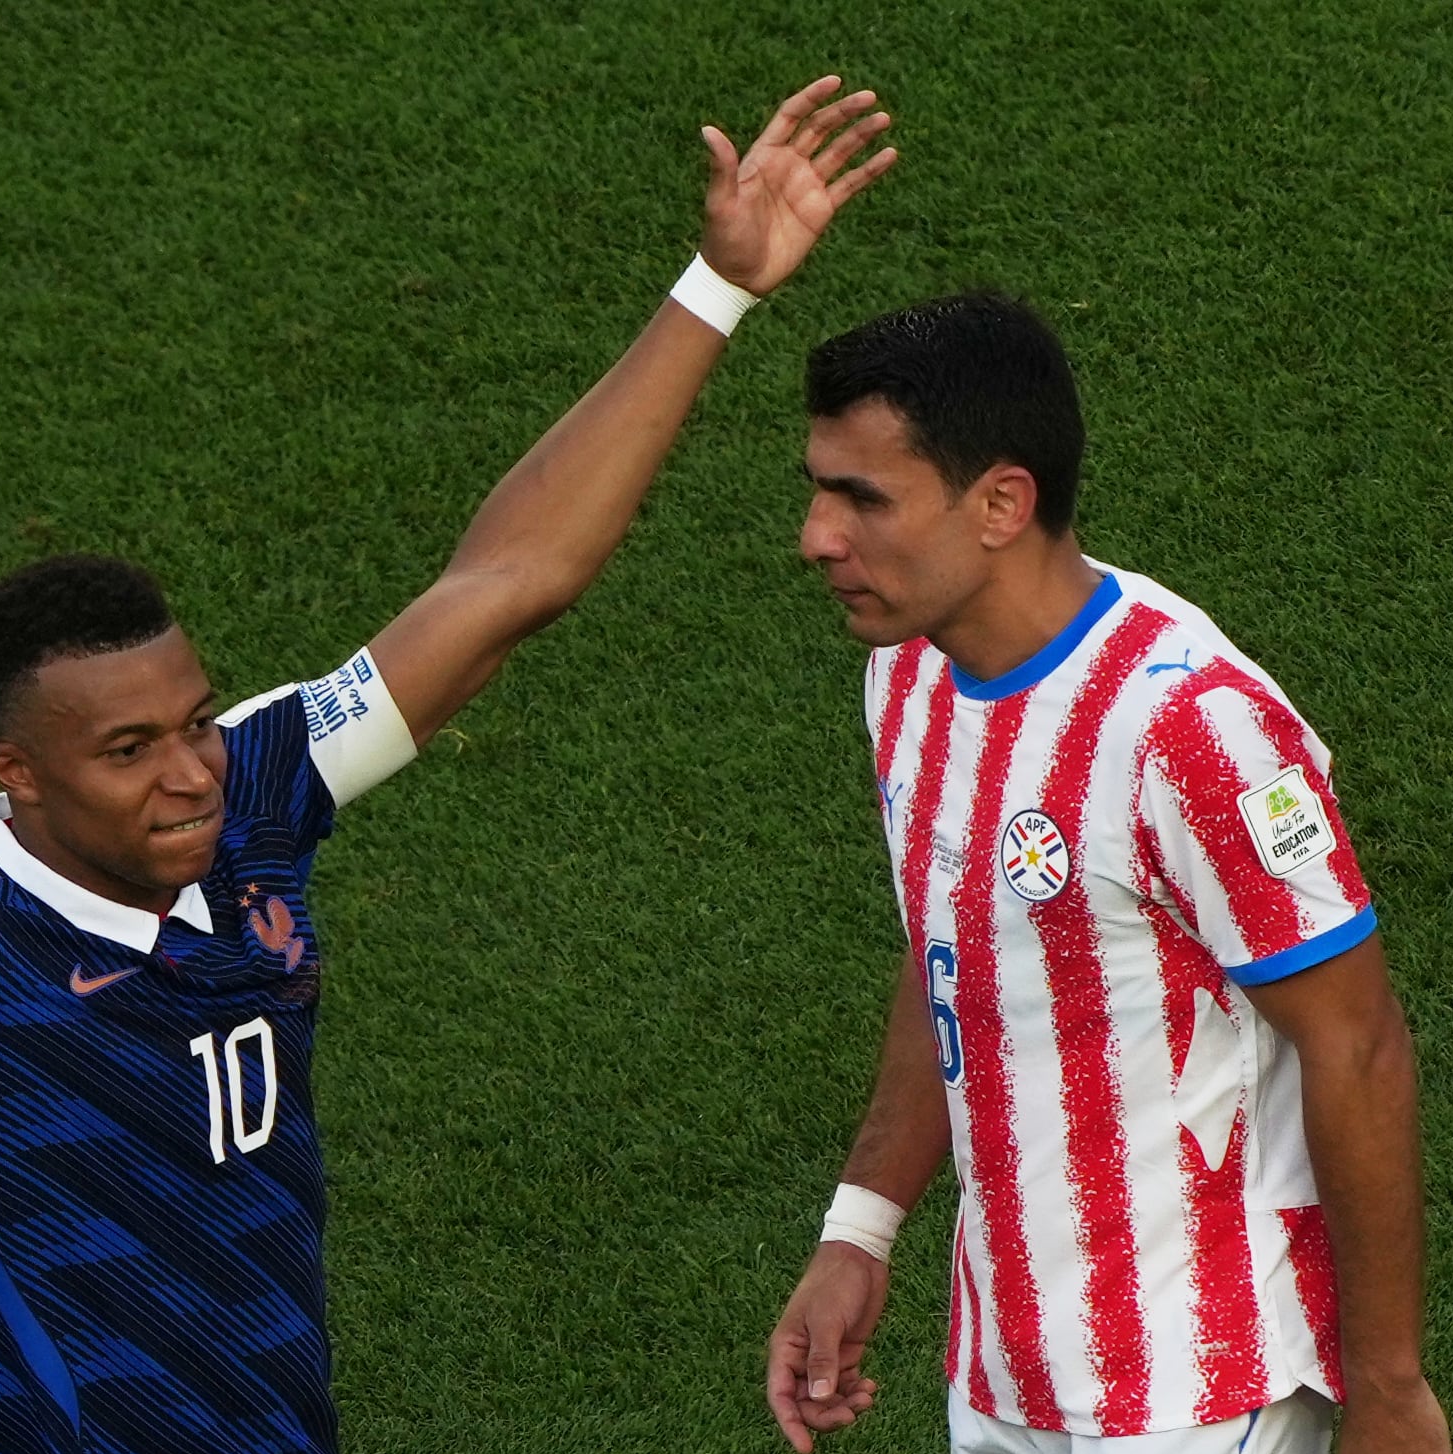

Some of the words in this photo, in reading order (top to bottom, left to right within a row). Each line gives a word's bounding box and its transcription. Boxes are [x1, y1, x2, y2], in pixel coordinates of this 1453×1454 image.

[347, 688, 369, 722] the
[1024, 816, 1048, 834] APF
[1272, 818, 1293, 840] Unite
[1291, 809, 1305, 827] For
[1272, 822, 1320, 859] EDUCATION
[1292, 847, 1310, 861] FIFA
[924, 938, 966, 1090] 6
[189, 1016, 278, 1165] 10
